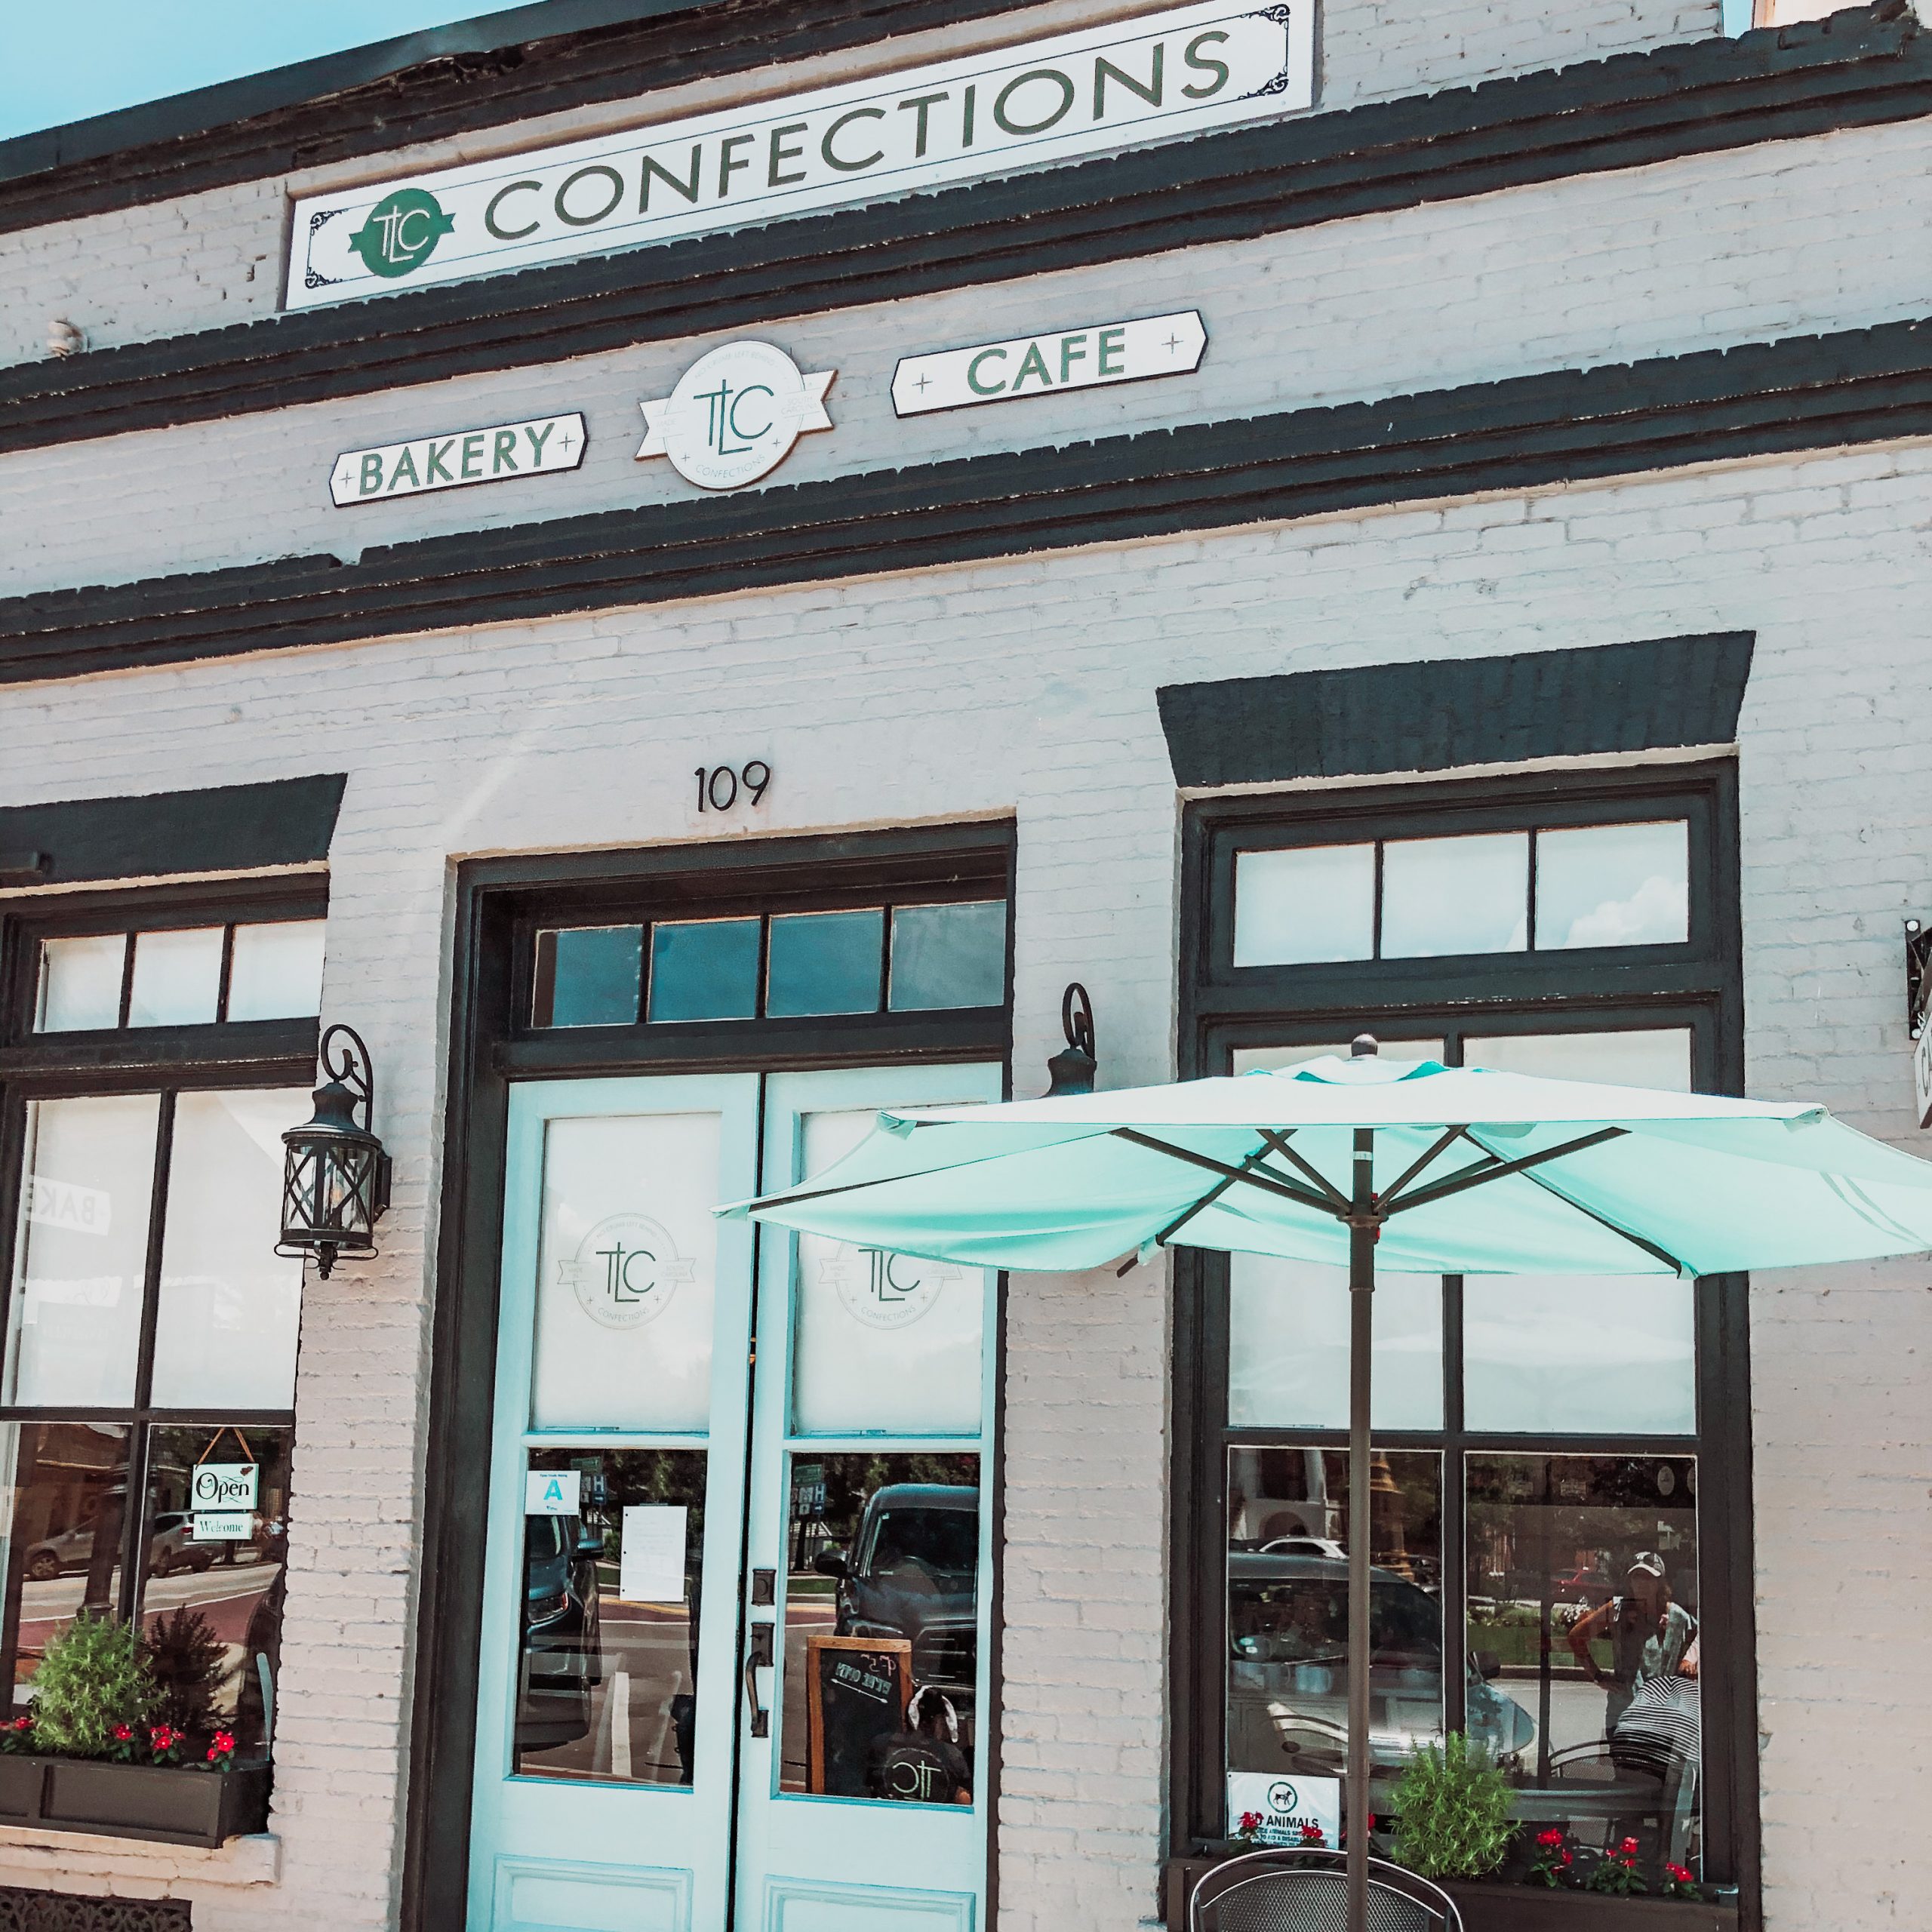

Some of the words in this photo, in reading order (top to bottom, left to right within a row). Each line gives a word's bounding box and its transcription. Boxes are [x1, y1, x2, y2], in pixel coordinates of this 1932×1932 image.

[485, 31, 1230, 240] CONFECTIONS
[374, 205, 430, 263] TLC
[968, 328, 1125, 396] CAFE
[694, 380, 774, 455] TLC
[359, 423, 555, 496] BAKERY
[695, 454, 766, 478] CONFECTIONS
[694, 761, 770, 813] 109
[596, 1241, 656, 1303] TLC
[598, 1306, 650, 1322] CONFECTIONS
[860, 1305, 916, 1322] CONFECTIONS
[195, 1472, 250, 1504] Open
[543, 1479, 563, 1501] A
[199, 1519, 243, 1533] Welcome
[1266, 1814, 1319, 1829] ANIMALS
